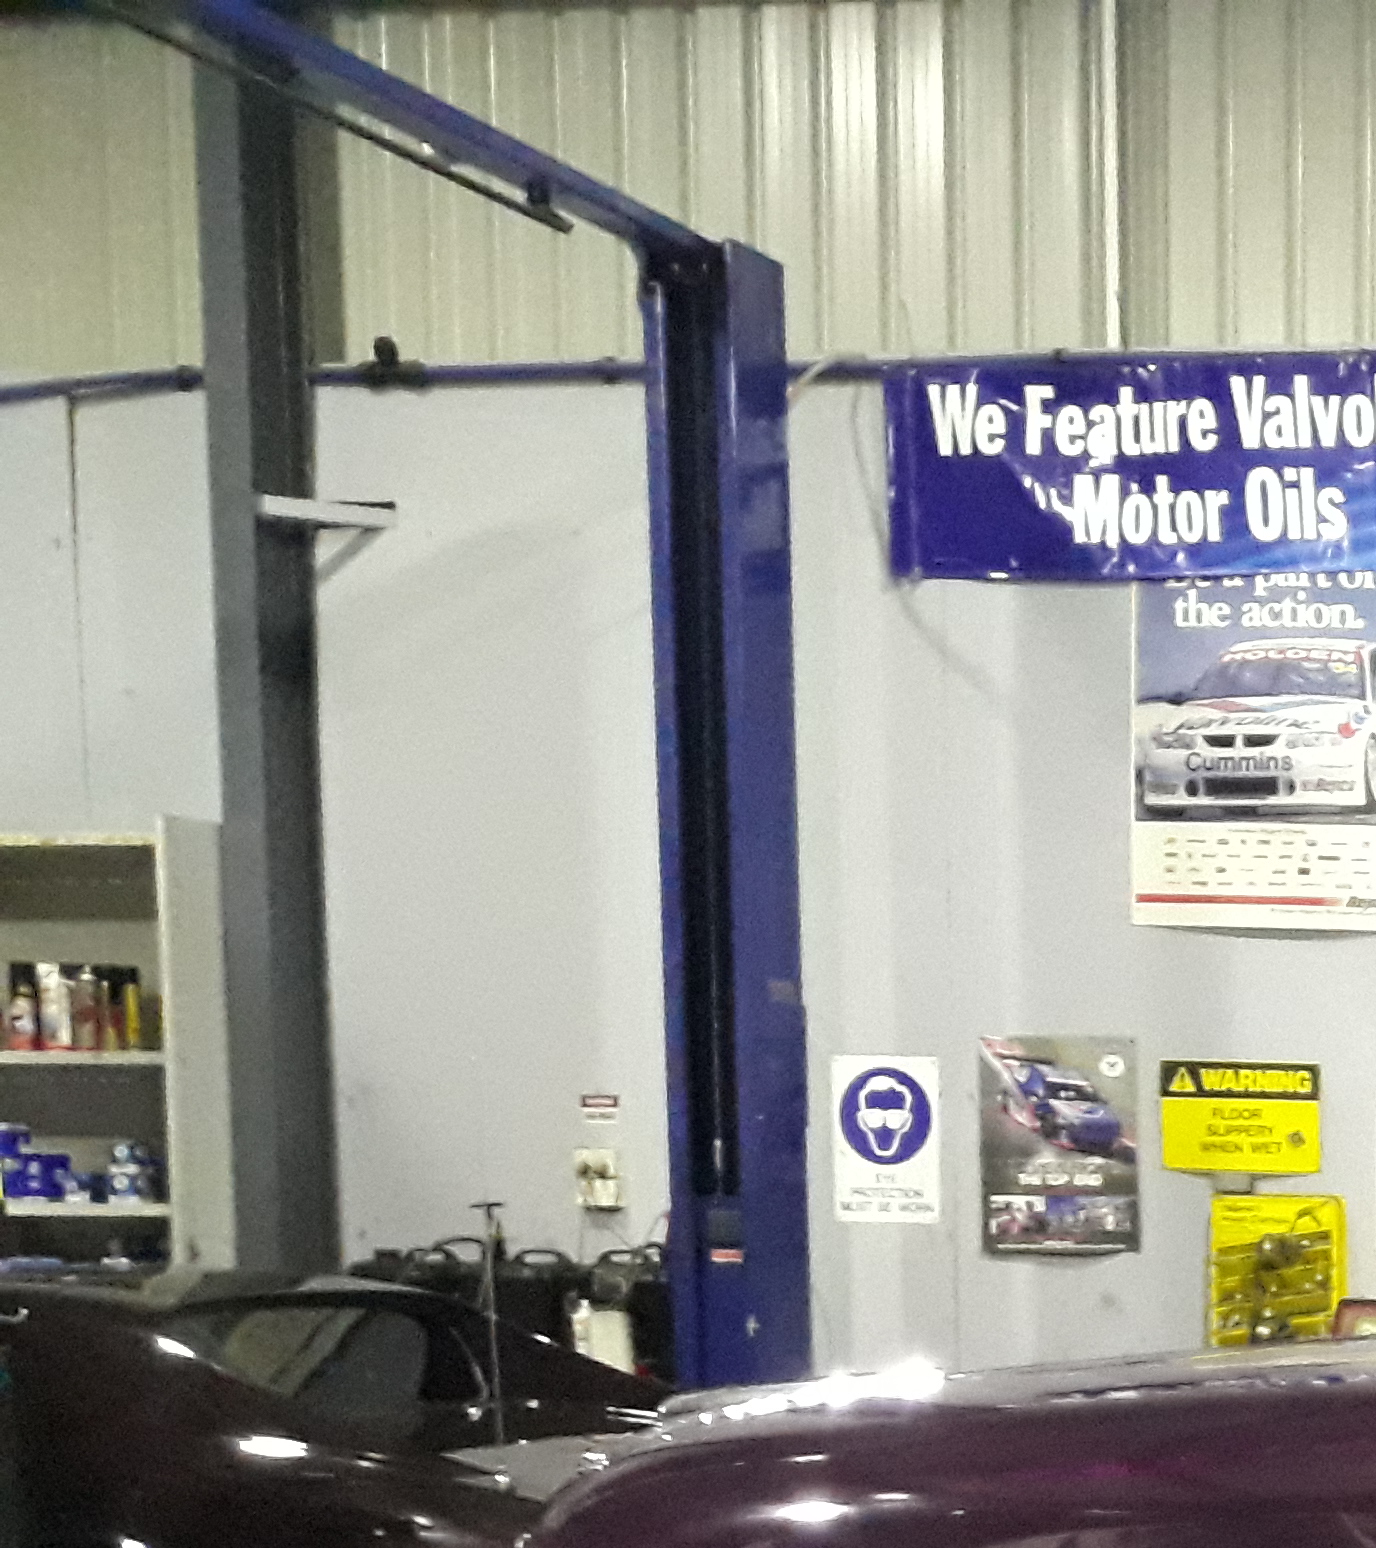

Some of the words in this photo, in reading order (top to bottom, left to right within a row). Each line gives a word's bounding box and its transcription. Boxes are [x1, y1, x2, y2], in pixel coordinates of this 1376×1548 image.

[927, 382, 1006, 458] We
[1023, 383, 1219, 458] Feature
[1071, 472, 1229, 547] Motor
[1245, 465, 1348, 543] Oils
[1174, 588, 1232, 628] the
[1241, 589, 1366, 630] action.
[1186, 752, 1295, 772] Cummins
[1199, 1067, 1313, 1093] WARNING
[1211, 1107, 1264, 1121] FLOOR
[1250, 1140, 1283, 1154] WET
